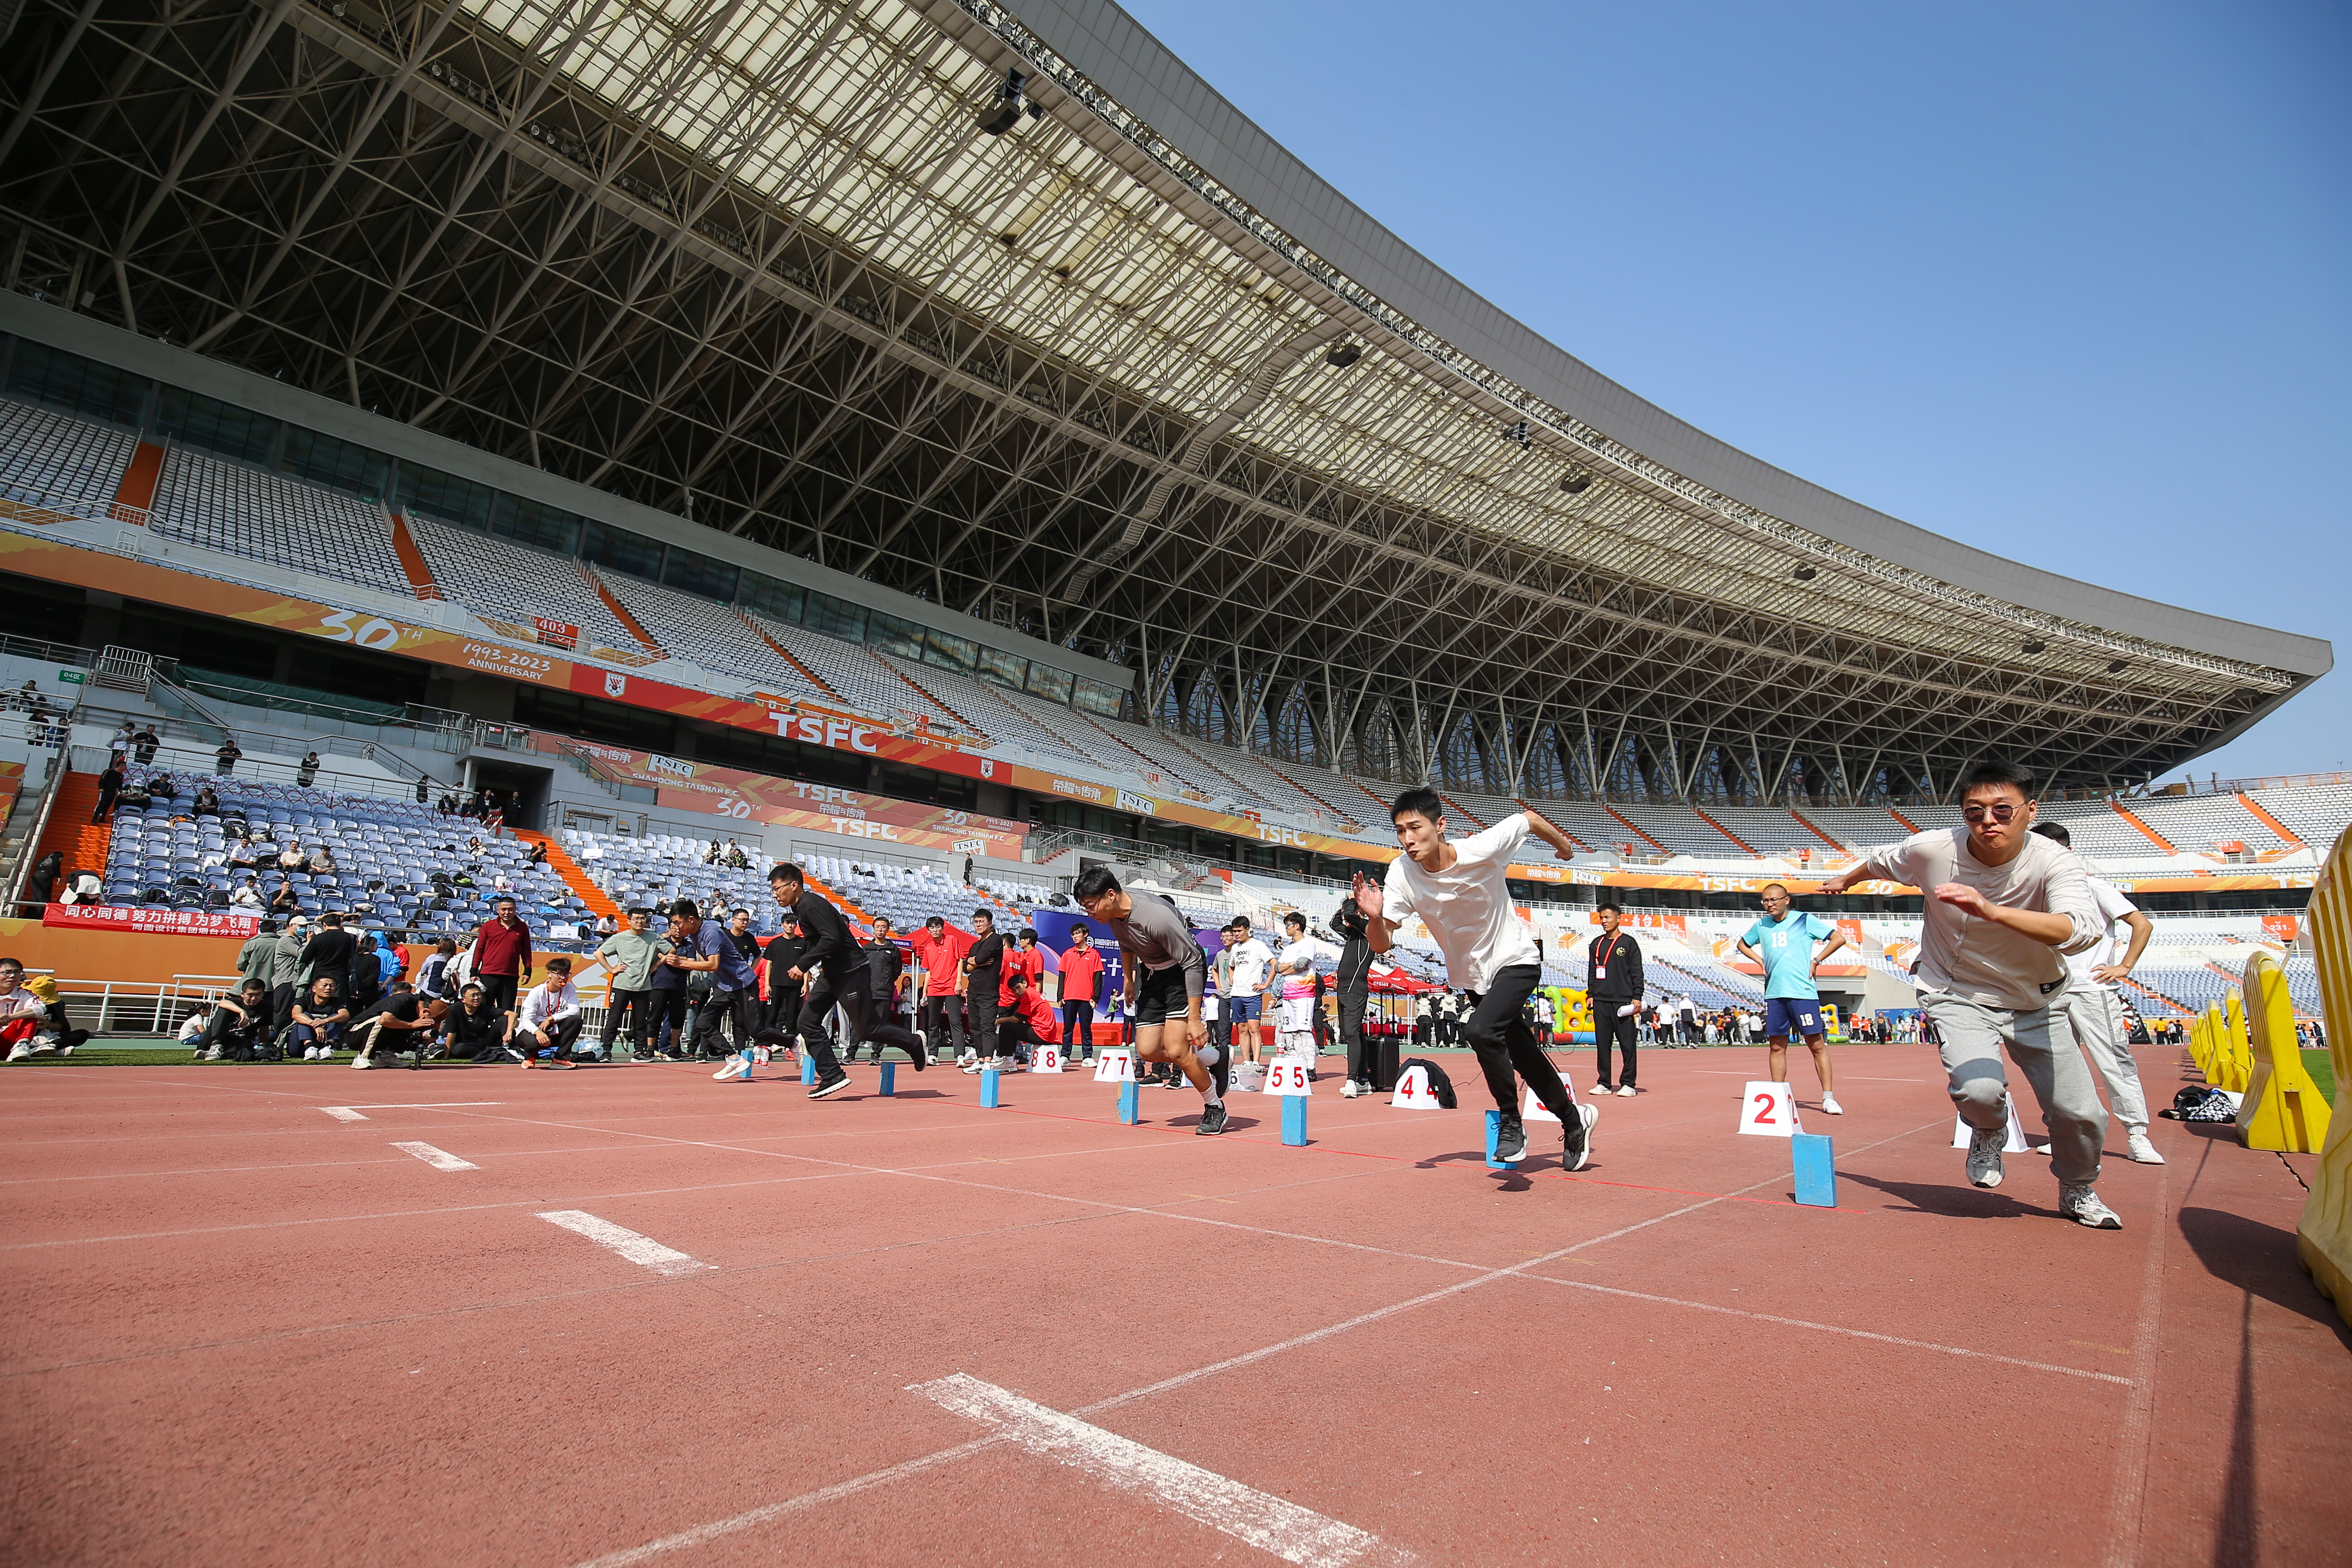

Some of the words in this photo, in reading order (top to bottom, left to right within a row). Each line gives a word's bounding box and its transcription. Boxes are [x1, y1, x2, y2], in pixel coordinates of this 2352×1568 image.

[539, 619, 566, 634] 403
[463, 642, 551, 671] 1993-2023
[467, 658, 544, 680] ANNIVERSARY
[769, 711, 877, 753] TSFC
[655, 756, 690, 773] TSFC
[632, 773, 683, 787] SHANDONG
[685, 782, 723, 794] TAISHAN
[1053, 779, 1102, 801] 荣耀与传承
[794, 782, 858, 804] TSFC
[1121, 792, 1150, 810] TSFC
[819, 803, 866, 819] 荣耀与传承
[831, 818, 897, 840] TSFC
[932, 824, 967, 835] SHANDONG
[968, 831, 994, 839] TAISHAN
[985, 818, 1014, 828] 1993-2023
[1255, 823, 1306, 846] TSFC
[956, 840, 982, 850] TSFC
[1527, 868, 1561, 880] 荣耀与传承
[1575, 871, 1599, 882] TSFC
[2272, 872, 2319, 888] TS
[1698, 877, 1756, 892] TSFC
[65, 904, 128, 921] 同心同德
[132, 909, 191, 925] 努力拼搏
[196, 913, 252, 930] 为梦飞翔
[132, 923, 250, 936] 同圆设计集团烟台分公司
[1771, 931, 1788, 948] 18
[1799, 1013, 1814, 1027] 18
[1031, 1051, 1038, 1067] 8
[1046, 1051, 1056, 1068] 8
[1102, 1057, 1110, 1074] 7
[1118, 1057, 1127, 1075] 7
[1230, 1071, 1238, 1084] 6
[1272, 1066, 1283, 1087] 5
[1294, 1067, 1303, 1088] 5
[1401, 1075, 1413, 1099] 4
[1754, 1093, 1775, 1124] 2
[1788, 1093, 1798, 1124] 2
